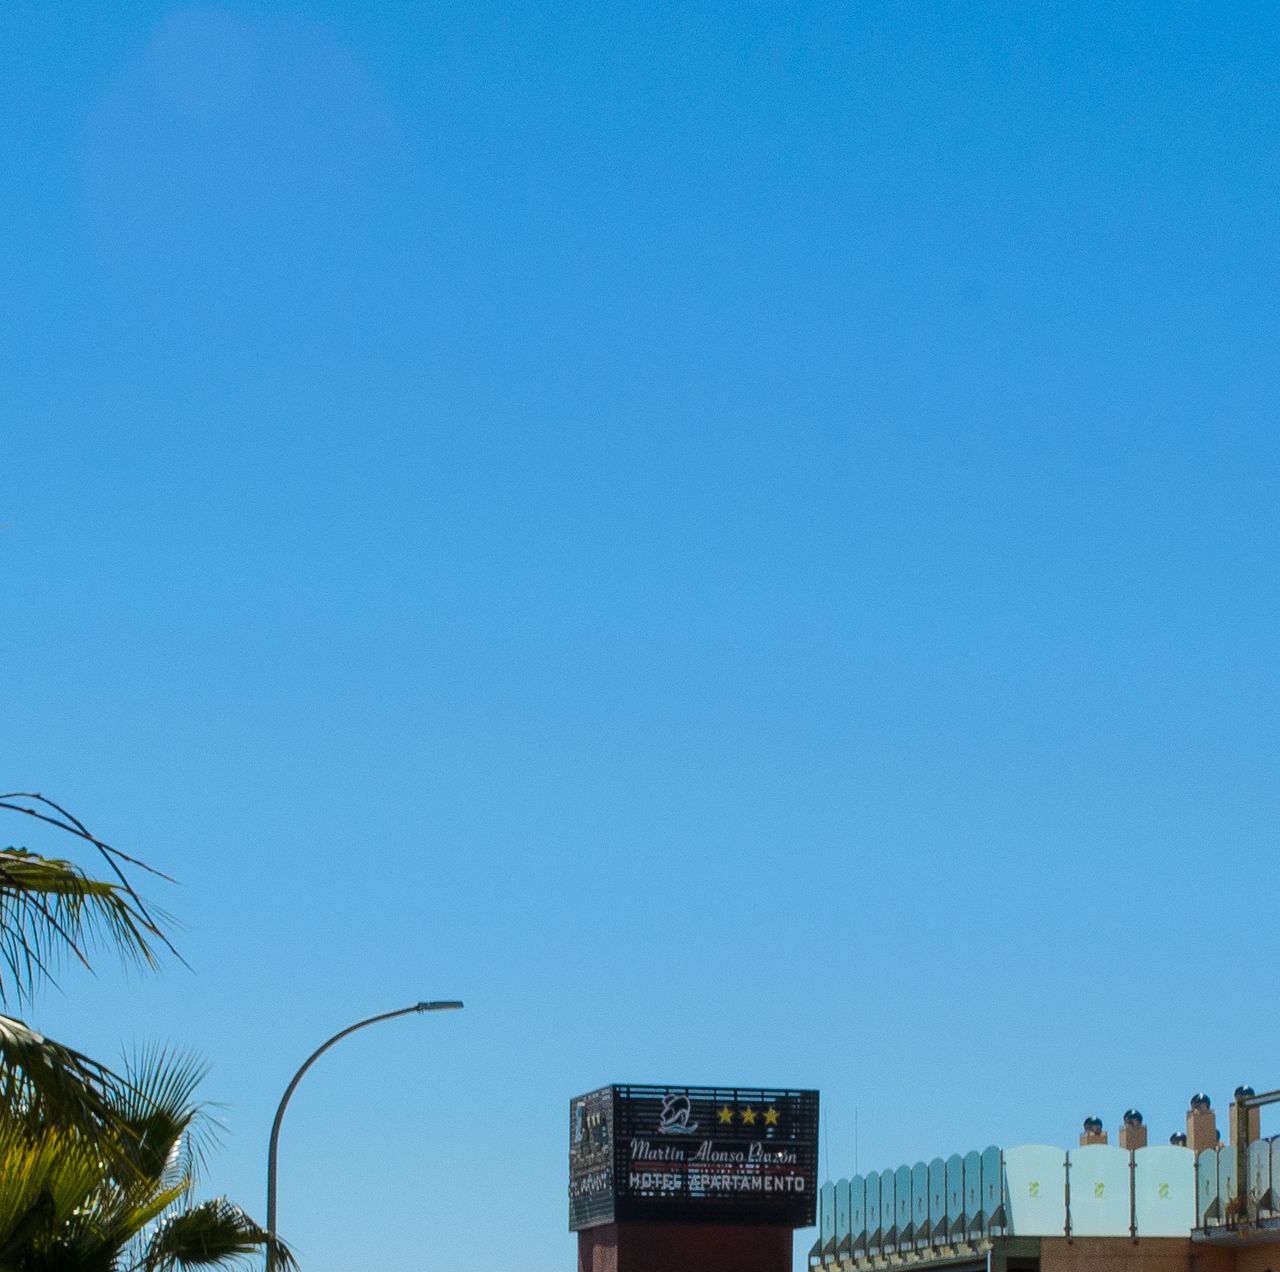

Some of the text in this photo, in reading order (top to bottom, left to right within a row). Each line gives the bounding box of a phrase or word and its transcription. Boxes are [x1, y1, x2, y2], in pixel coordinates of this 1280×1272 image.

[687, 1140, 744, 1162] Alonso
[629, 1172, 682, 1189] HOTEL
[688, 1174, 805, 1192] APARTAMENTO
